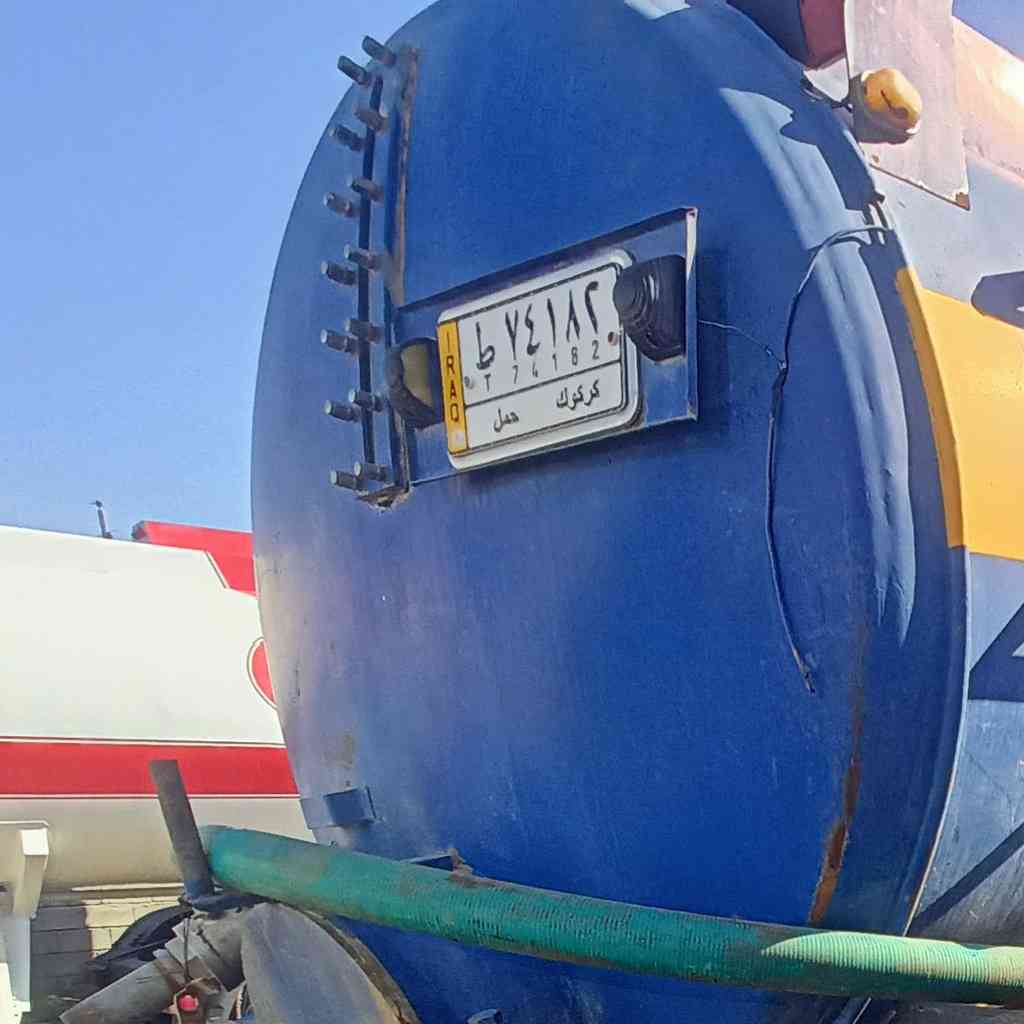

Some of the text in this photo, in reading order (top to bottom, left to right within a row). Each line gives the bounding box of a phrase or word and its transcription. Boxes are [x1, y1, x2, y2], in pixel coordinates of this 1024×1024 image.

[504, 281, 600, 360] ٧٤١٨٢
[445, 332, 460, 423] IRAQ
[512, 340, 600, 384] 74182
